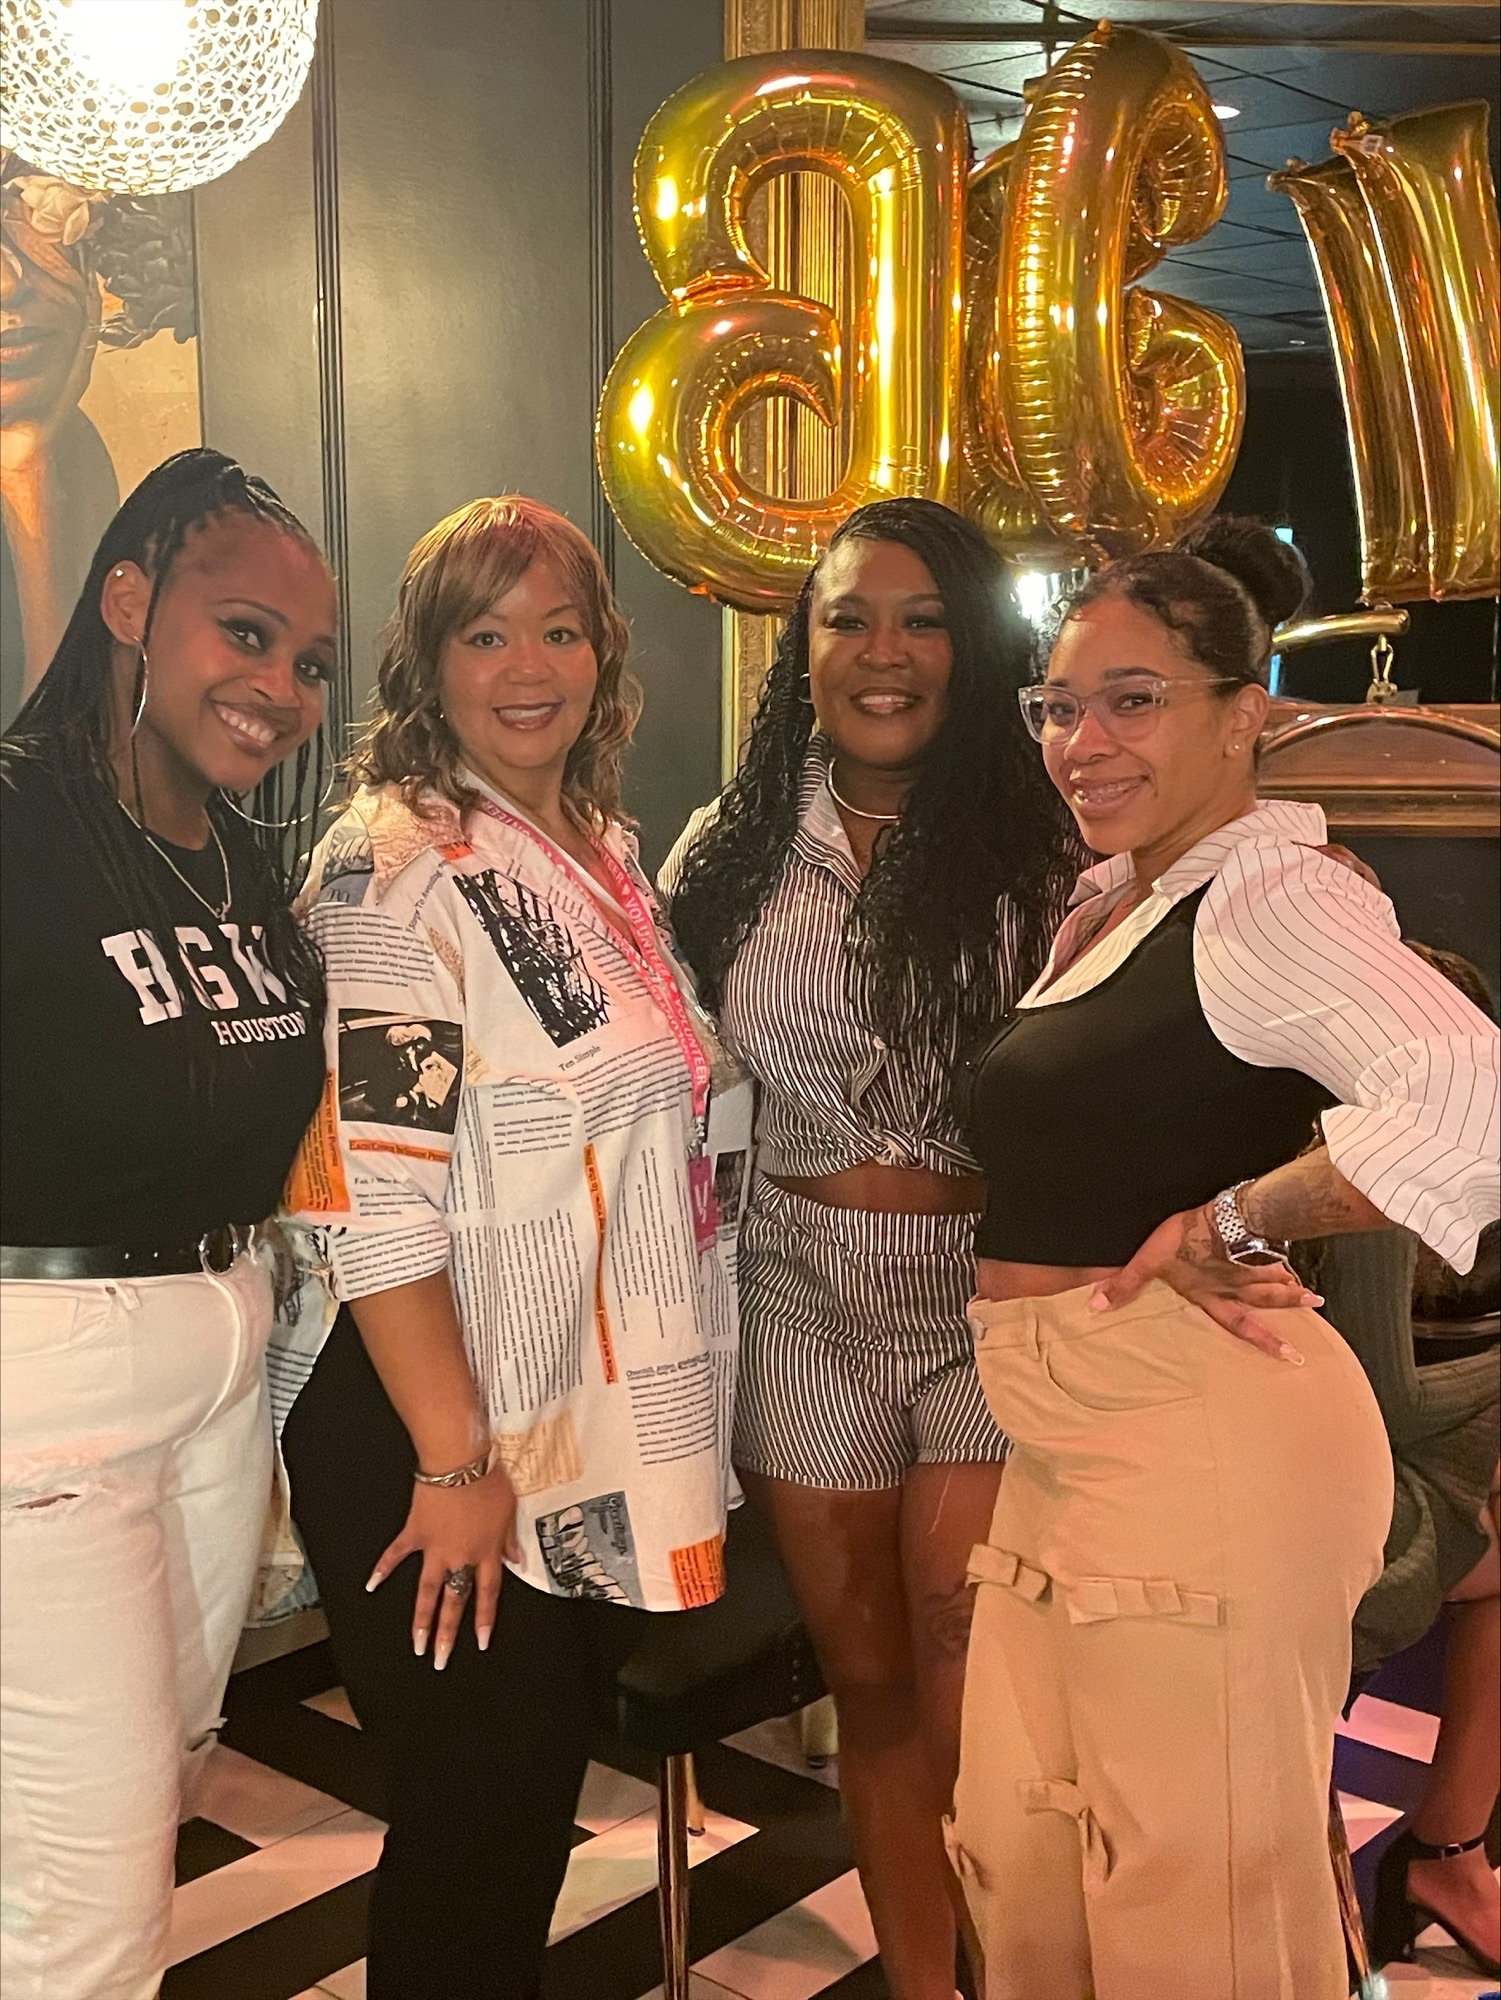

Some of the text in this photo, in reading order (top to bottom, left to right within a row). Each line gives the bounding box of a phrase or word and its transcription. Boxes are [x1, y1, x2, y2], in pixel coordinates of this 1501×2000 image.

[622, 896, 673, 978] VOLUNTEER
[210, 1011, 307, 1046] HOUSTON
[673, 998, 708, 1085] VOLUNTEER
